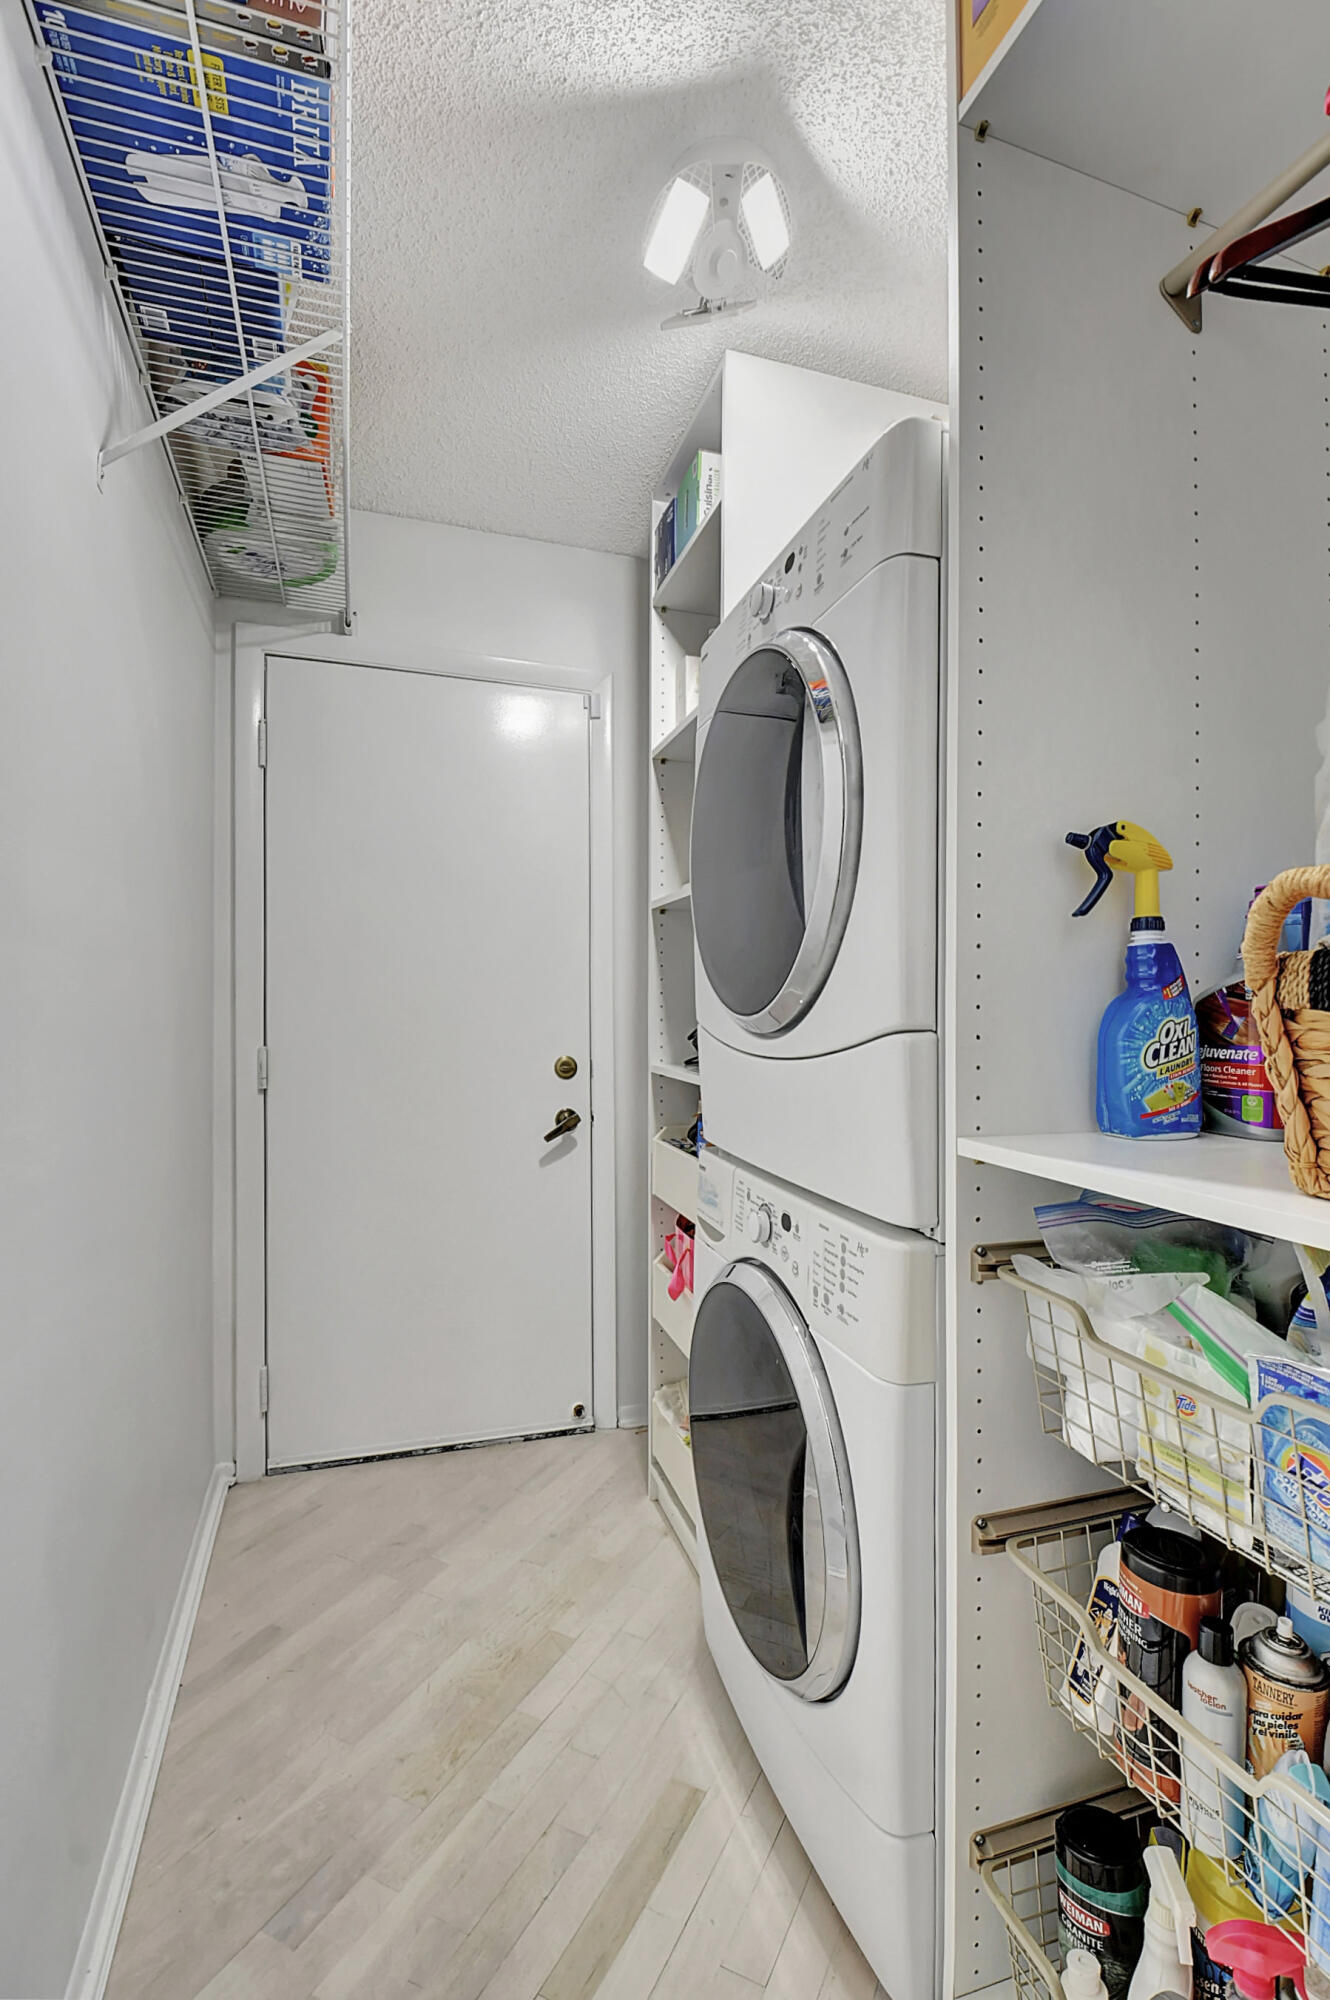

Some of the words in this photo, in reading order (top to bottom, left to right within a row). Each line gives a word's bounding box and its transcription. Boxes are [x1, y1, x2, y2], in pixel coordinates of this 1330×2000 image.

[214, 88, 225, 110] LSTS
[291, 79, 320, 167] BRITA
[1160, 1019, 1188, 1045] OXI
[1145, 1033, 1195, 1068] CLEAN
[1199, 1044, 1258, 1061] ejuvenate
[1160, 1058, 1193, 1075] LAUNDRY
[1223, 1065, 1256, 1076] Cleaner
[1177, 1396, 1196, 1411] Tide
[1287, 1451, 1330, 1508] Tid
[1119, 1583, 1143, 1613] MAN
[1253, 1676, 1296, 1706] TANNERY
[1248, 1708, 1269, 1718] para
[1271, 1711, 1303, 1721] cuidar
[1253, 1716, 1266, 1726] las
[1268, 1721, 1299, 1730] pieles
[1258, 1728, 1267, 1736] el
[1268, 1730, 1298, 1739] vinilo
[1060, 1890, 1103, 1934] WEIMAN
[1061, 1913, 1104, 1952] GRANITE
